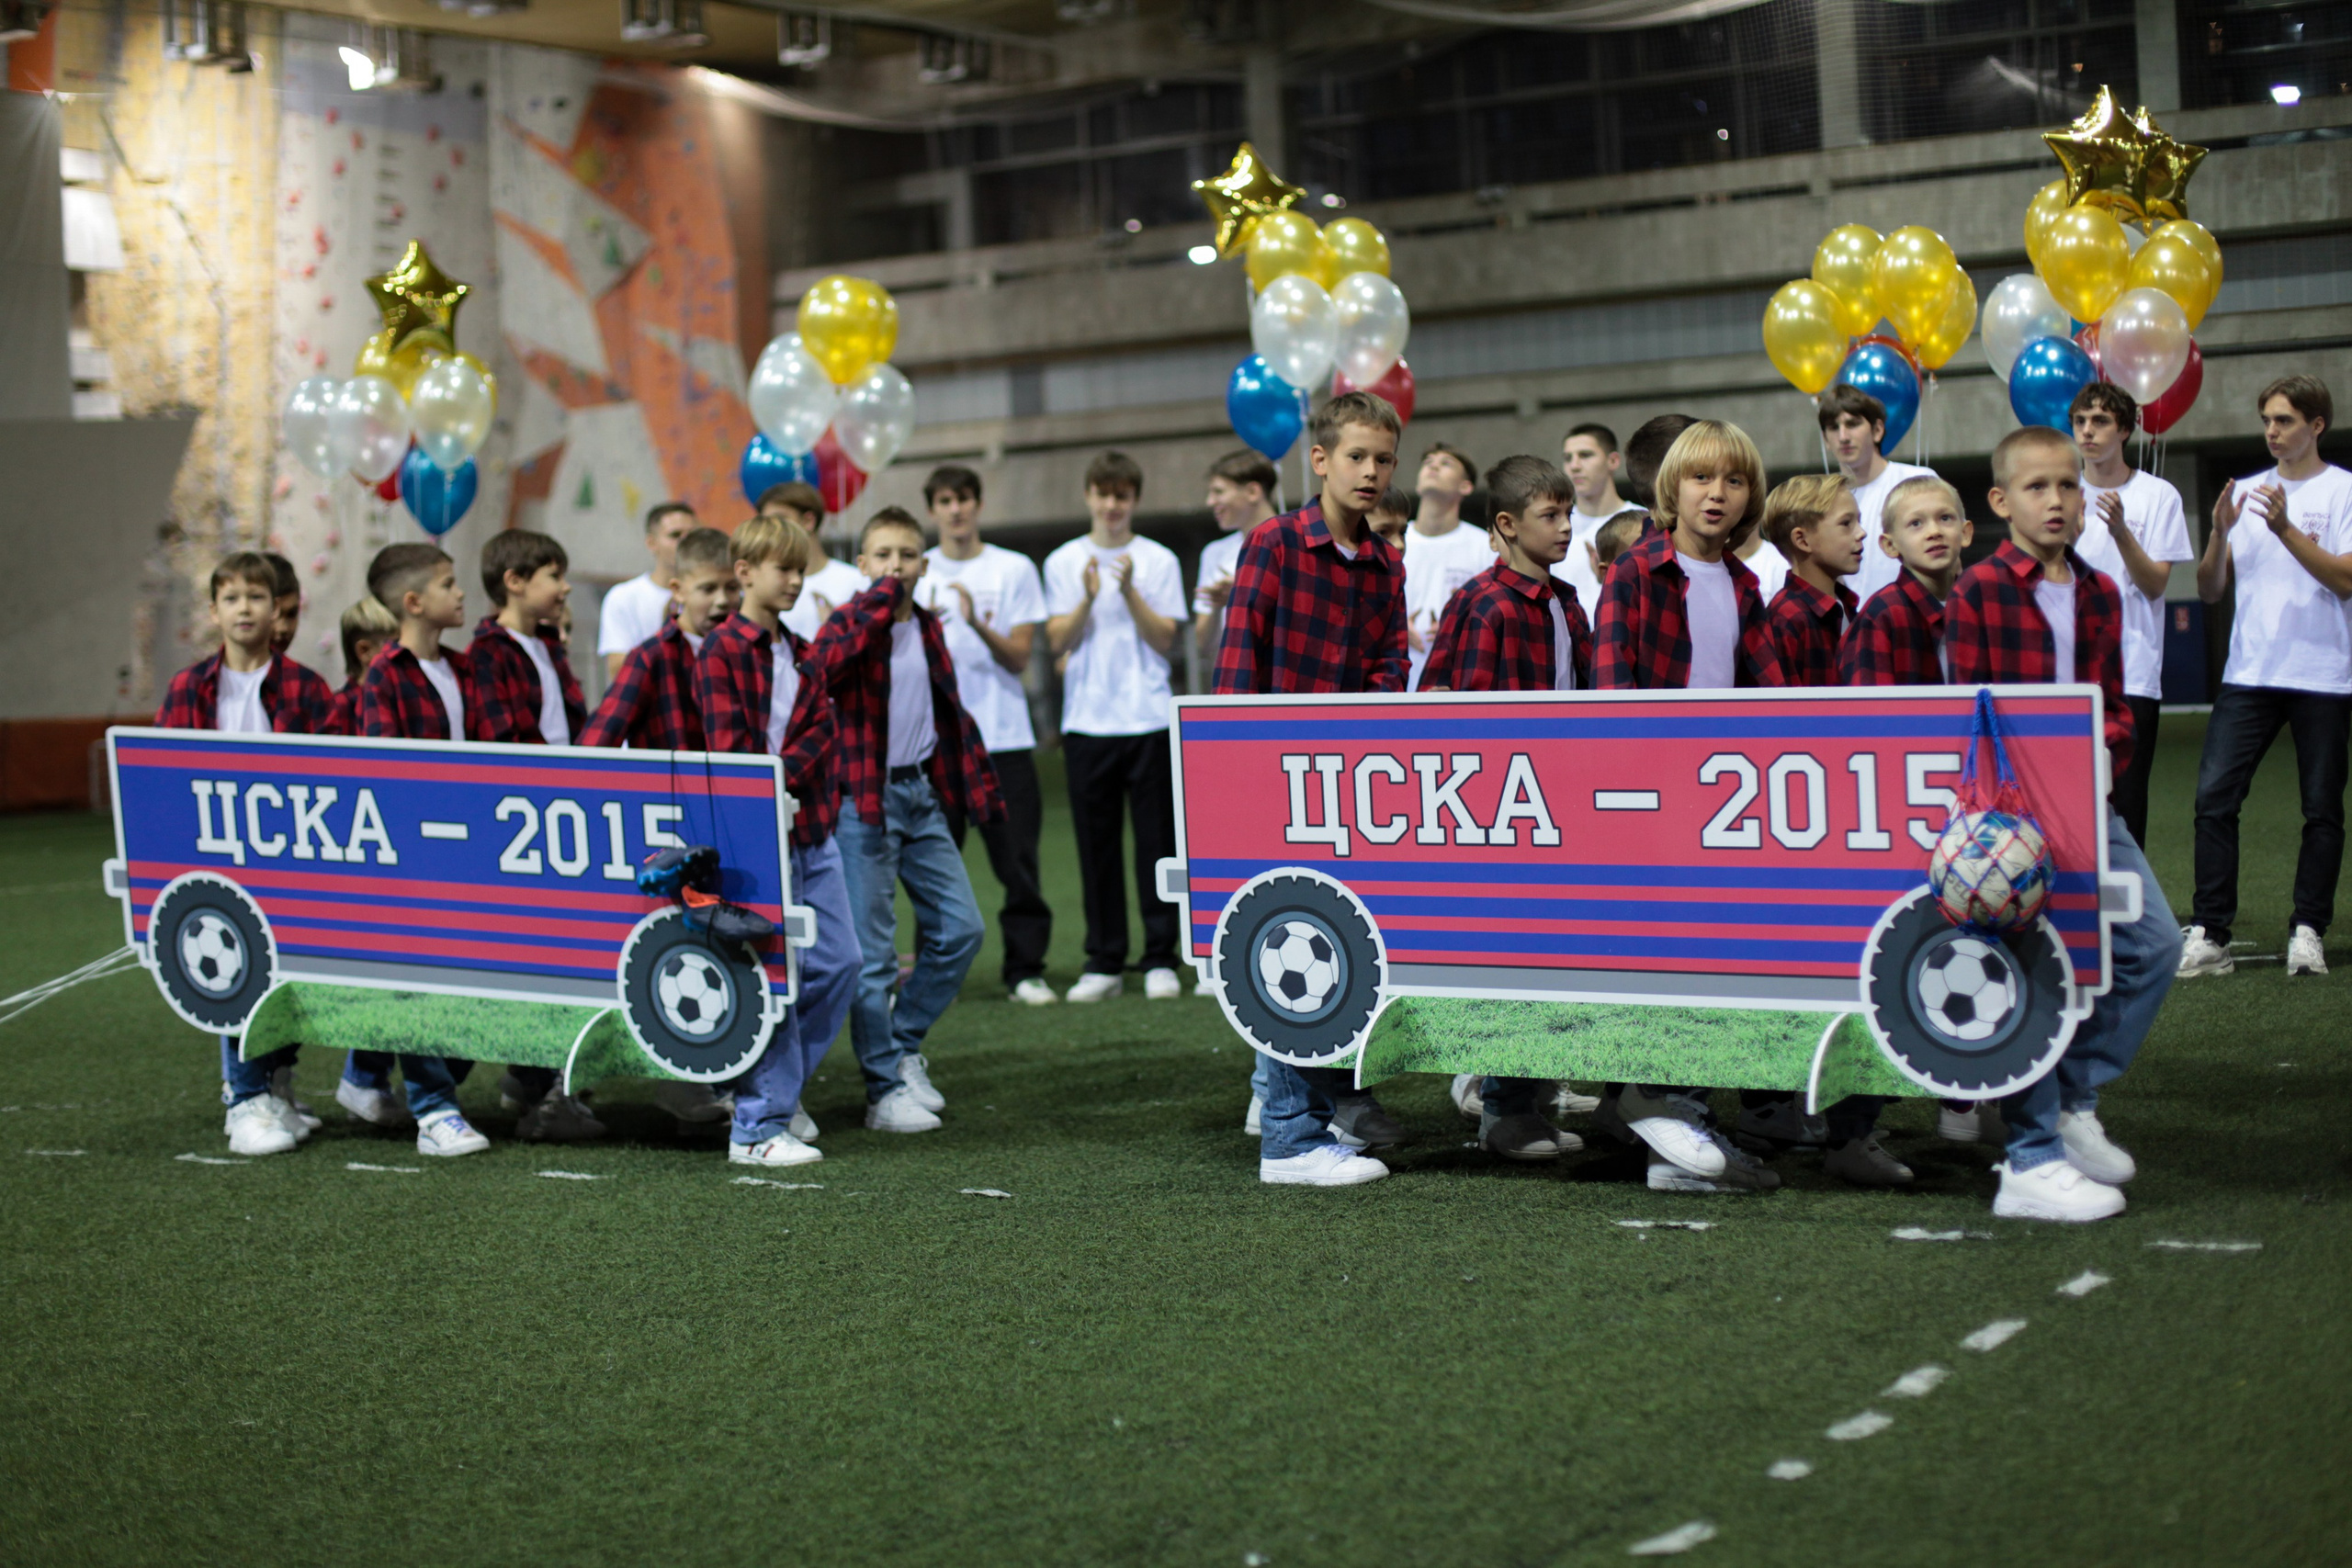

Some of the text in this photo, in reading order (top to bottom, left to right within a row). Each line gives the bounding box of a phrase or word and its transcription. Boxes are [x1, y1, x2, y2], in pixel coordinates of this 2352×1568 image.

[190, 779, 399, 866] ЦСКА
[494, 795, 689, 881] 2015
[1282, 752, 1562, 857] ЦСКА
[1698, 751, 1964, 851] 2015
